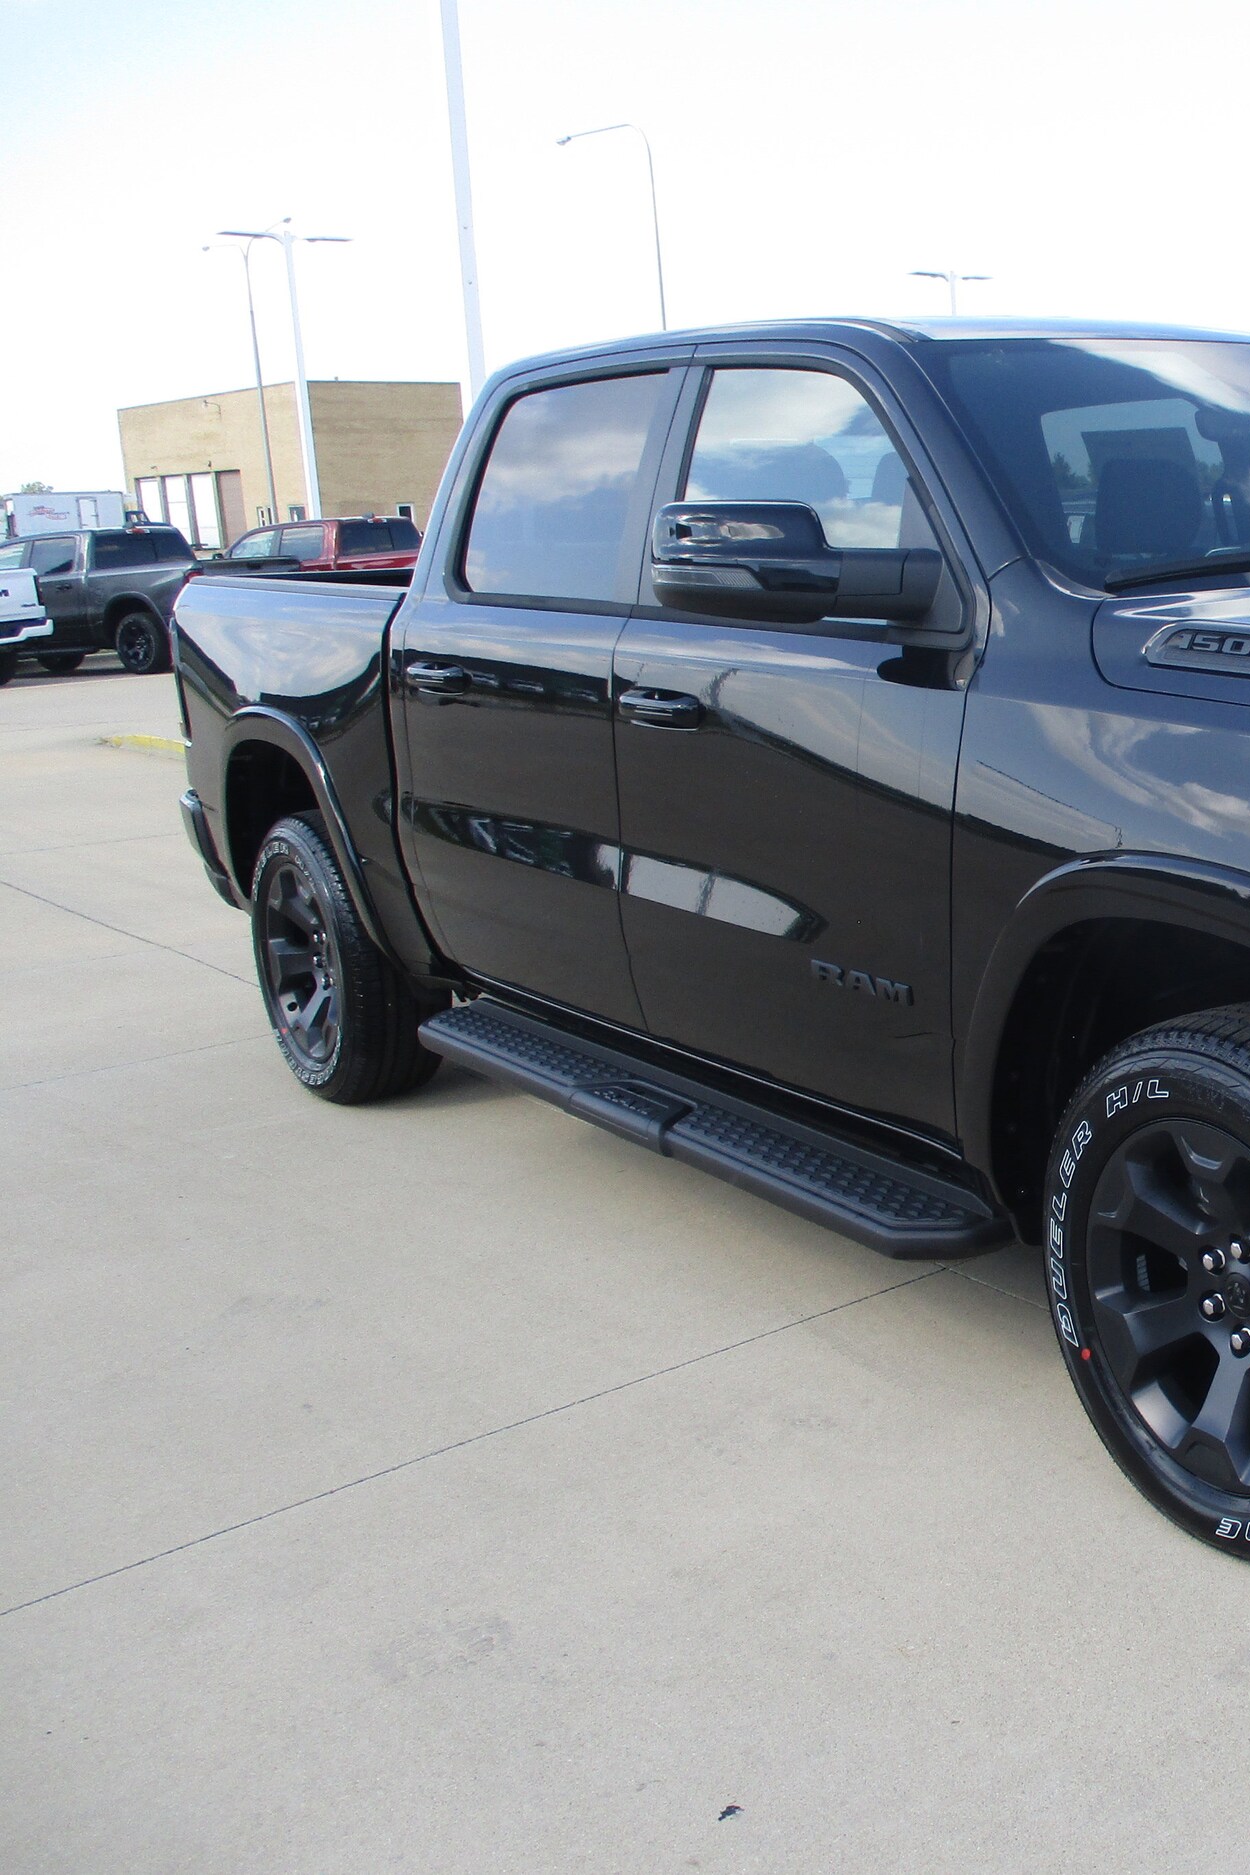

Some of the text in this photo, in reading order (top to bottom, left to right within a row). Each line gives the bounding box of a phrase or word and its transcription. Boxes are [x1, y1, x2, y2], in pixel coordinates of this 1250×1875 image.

[810, 957, 915, 1007] RAM
[1104, 1078, 1170, 1118] H/L
[1047, 1119, 1093, 1349] DUELER
